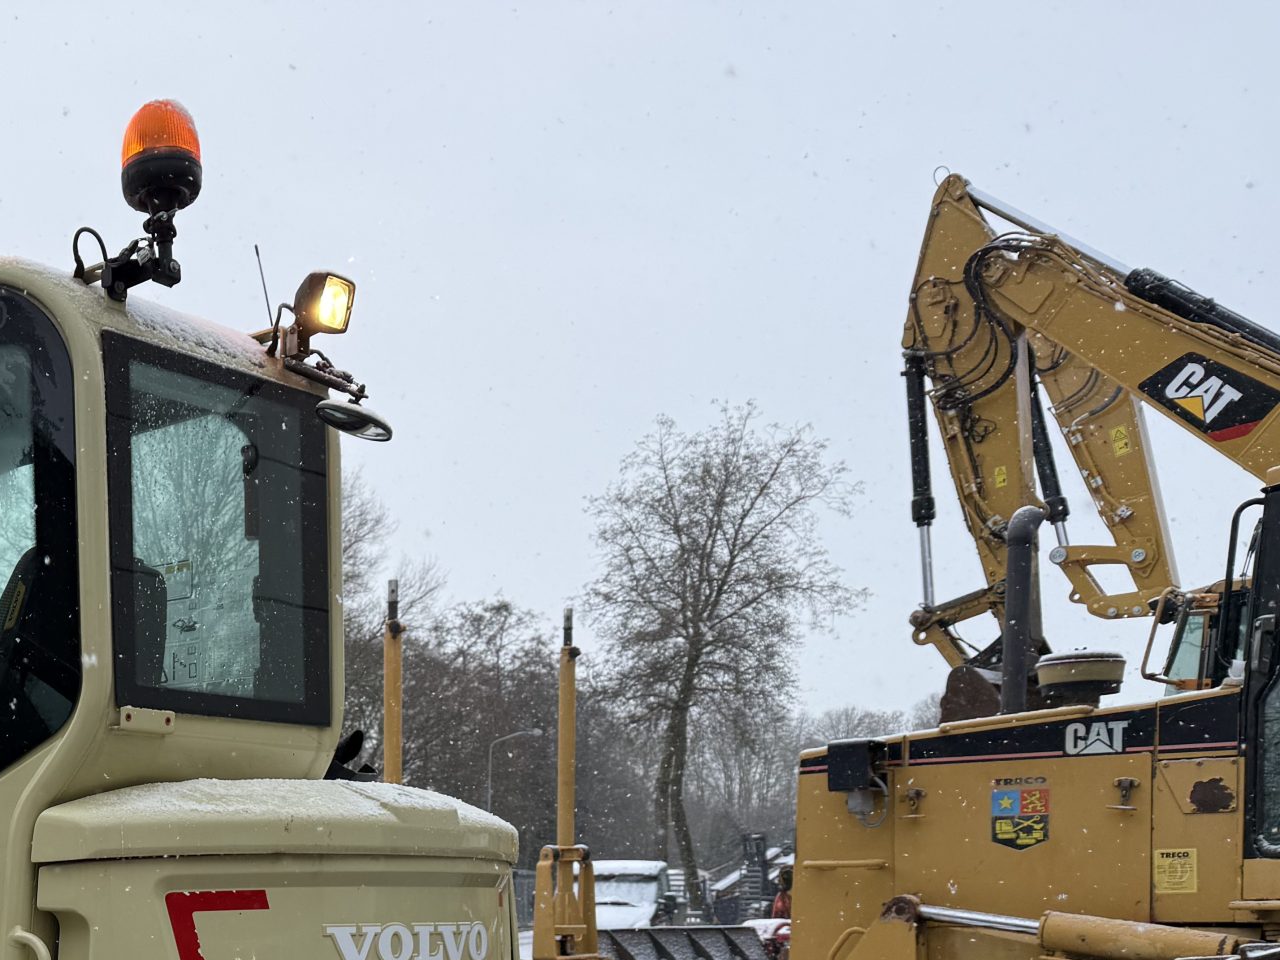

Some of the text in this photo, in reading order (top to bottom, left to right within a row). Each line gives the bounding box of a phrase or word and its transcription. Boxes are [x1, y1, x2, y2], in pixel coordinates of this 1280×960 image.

[1165, 363, 1243, 424] CAT
[1065, 720, 1129, 755] CAT
[1160, 851, 1190, 859] TRECO
